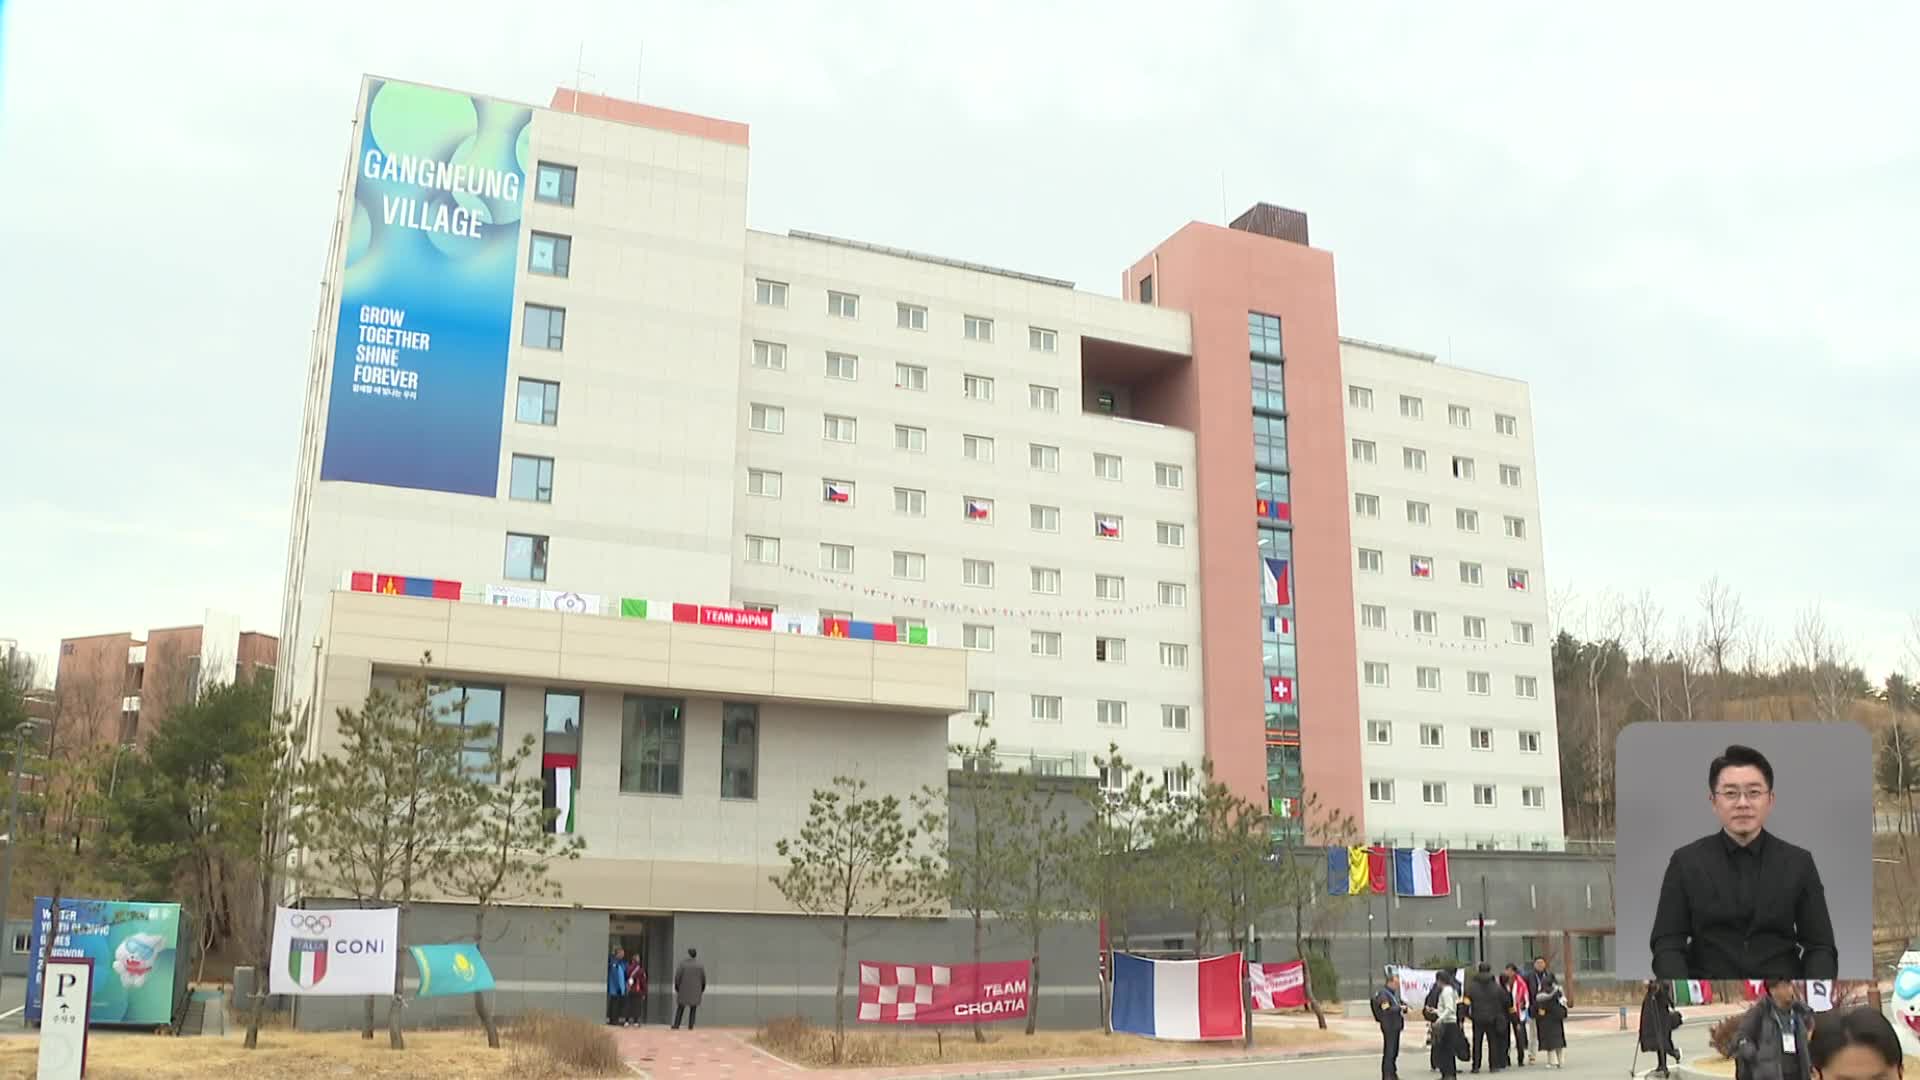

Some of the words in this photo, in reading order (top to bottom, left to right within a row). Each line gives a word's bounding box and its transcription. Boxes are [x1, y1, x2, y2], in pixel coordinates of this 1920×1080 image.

[364, 150, 519, 203] GANGNEUNG
[382, 194, 482, 238] VILLAGE
[360, 305, 404, 327] GROW
[359, 325, 430, 350] TOGETHER
[356, 345, 399, 367] SHINE
[354, 364, 418, 389] FOREVER
[705, 609, 734, 624] TEAM
[735, 614, 768, 626] JAPAN
[335, 938, 384, 954] CONI
[56, 973, 76, 997] P
[984, 979, 1026, 997] TEAM
[954, 998, 1025, 1016] CROATIA
